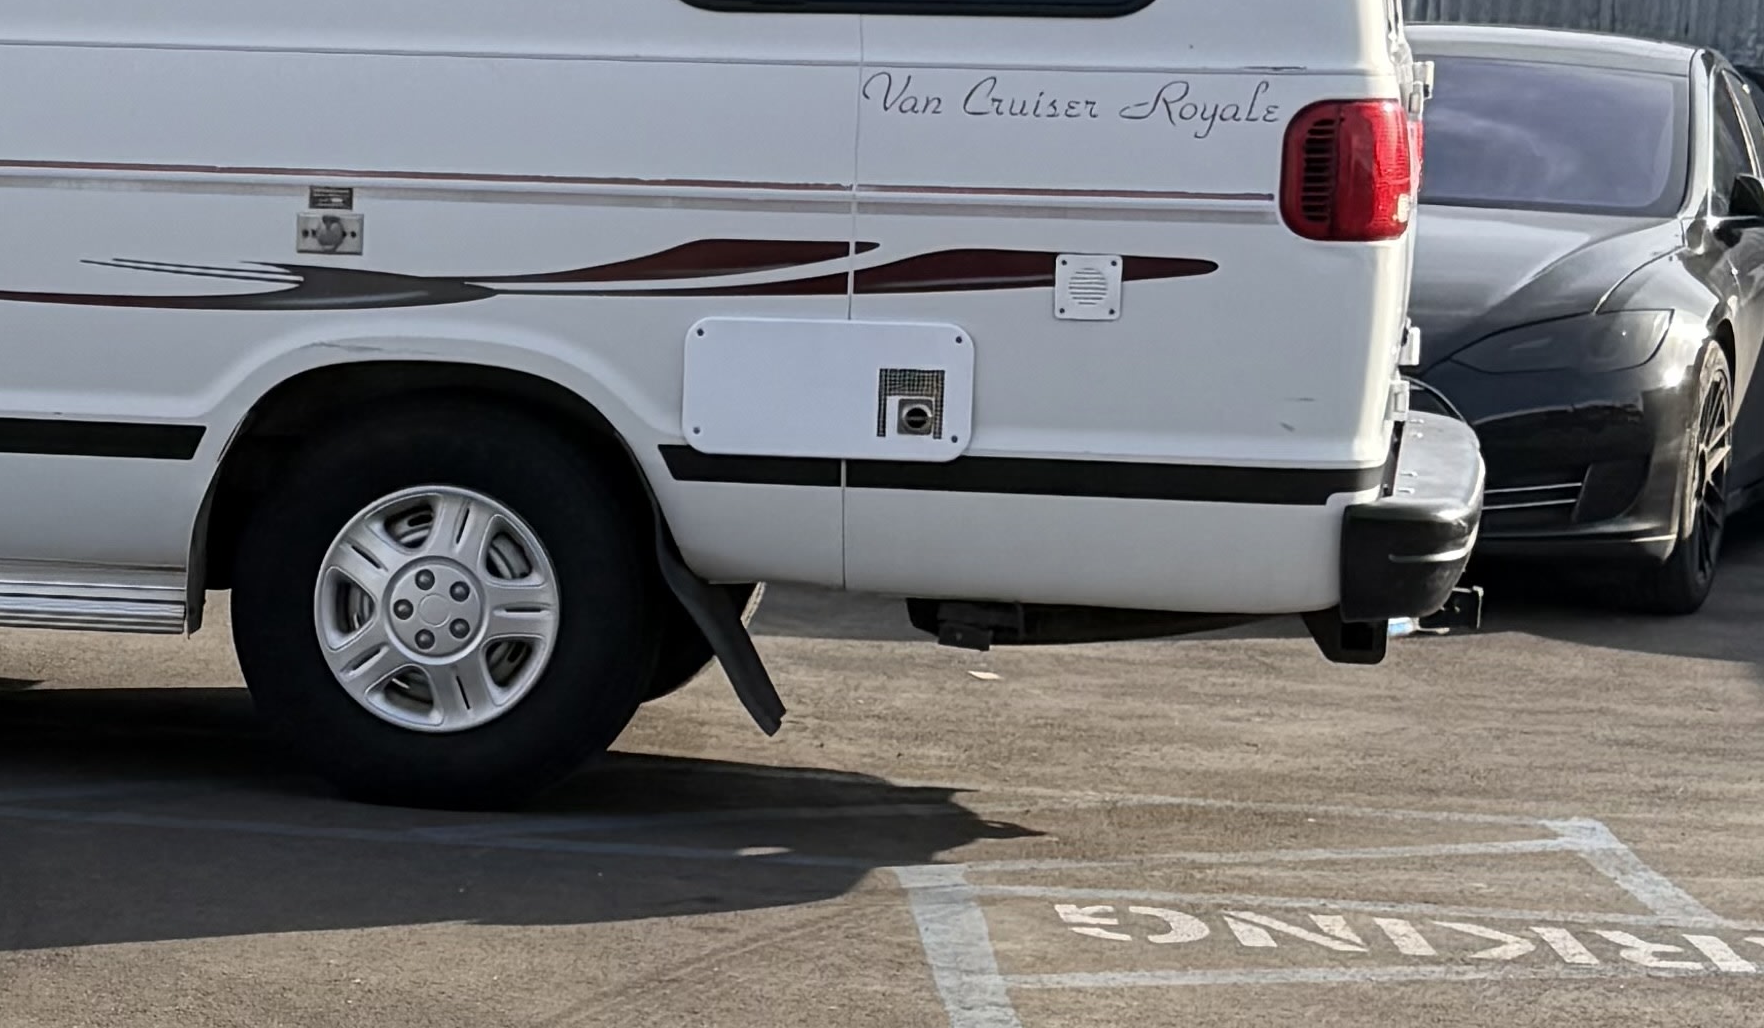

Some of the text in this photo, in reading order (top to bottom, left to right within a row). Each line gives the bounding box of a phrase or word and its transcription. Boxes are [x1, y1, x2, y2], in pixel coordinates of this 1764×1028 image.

[862, 71, 1280, 139] Van Cruiser Royale
[1054, 903, 1763, 973] RKING
